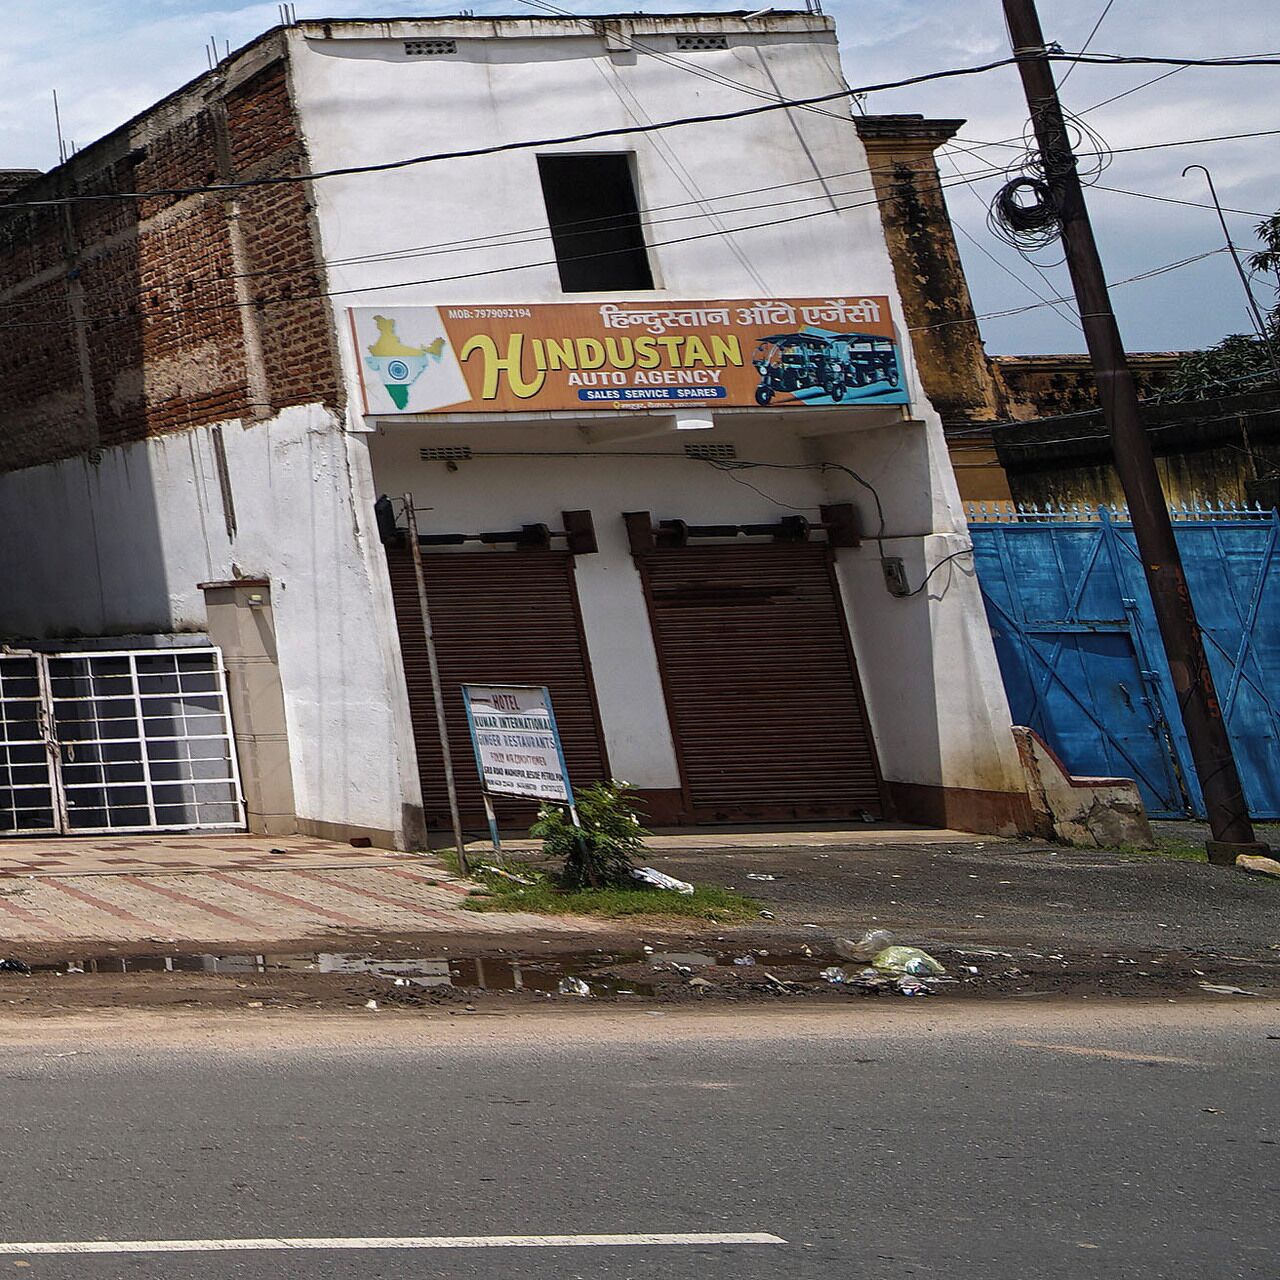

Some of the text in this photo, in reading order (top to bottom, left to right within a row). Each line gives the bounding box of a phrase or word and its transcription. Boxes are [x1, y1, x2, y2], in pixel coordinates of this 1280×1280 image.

[449, 309, 532, 320] MOB: 7979092194
[600, 298, 882, 334] हिन्दुस्तान ऑटो एजेंसी
[460, 333, 743, 400] HINDUSTAN
[567, 370, 721, 386] AUTO AGENCY
[587, 388, 717, 399] SALES SERVICE SPARES
[491, 694, 520, 711] HOTEL
